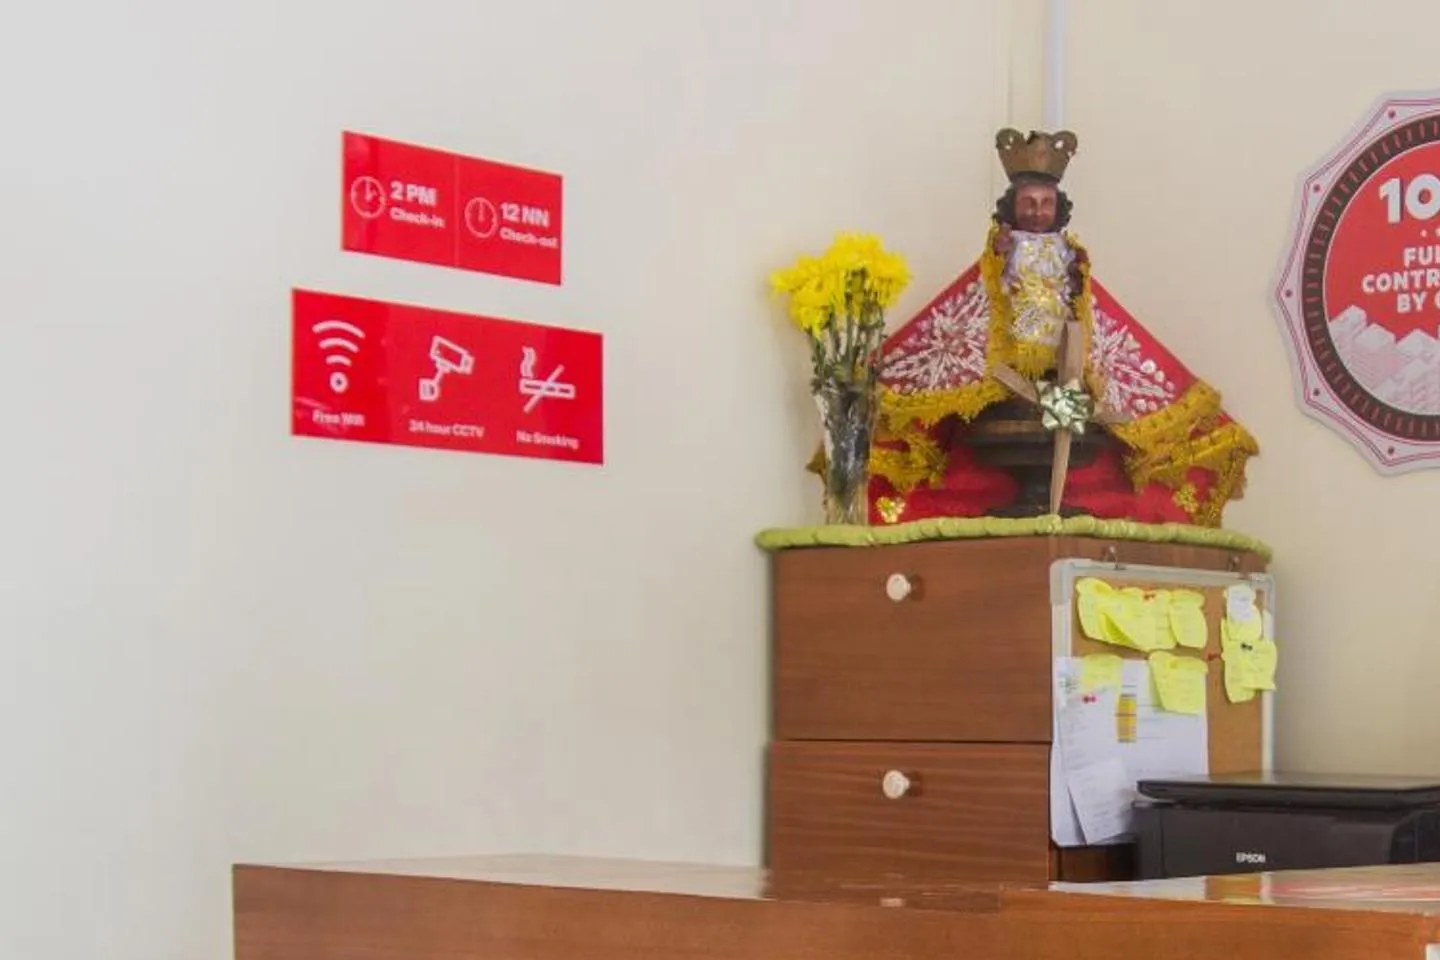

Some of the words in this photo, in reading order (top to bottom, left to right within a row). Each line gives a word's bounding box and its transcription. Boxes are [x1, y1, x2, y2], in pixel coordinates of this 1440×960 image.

[390, 181, 403, 200] 2
[406, 184, 438, 206] PM
[500, 202, 520, 222] 12
[521, 206, 550, 227] NN
[1396, 292, 1428, 314] BY
[452, 423, 486, 438] CCTV
[1235, 851, 1266, 863] EPSON
